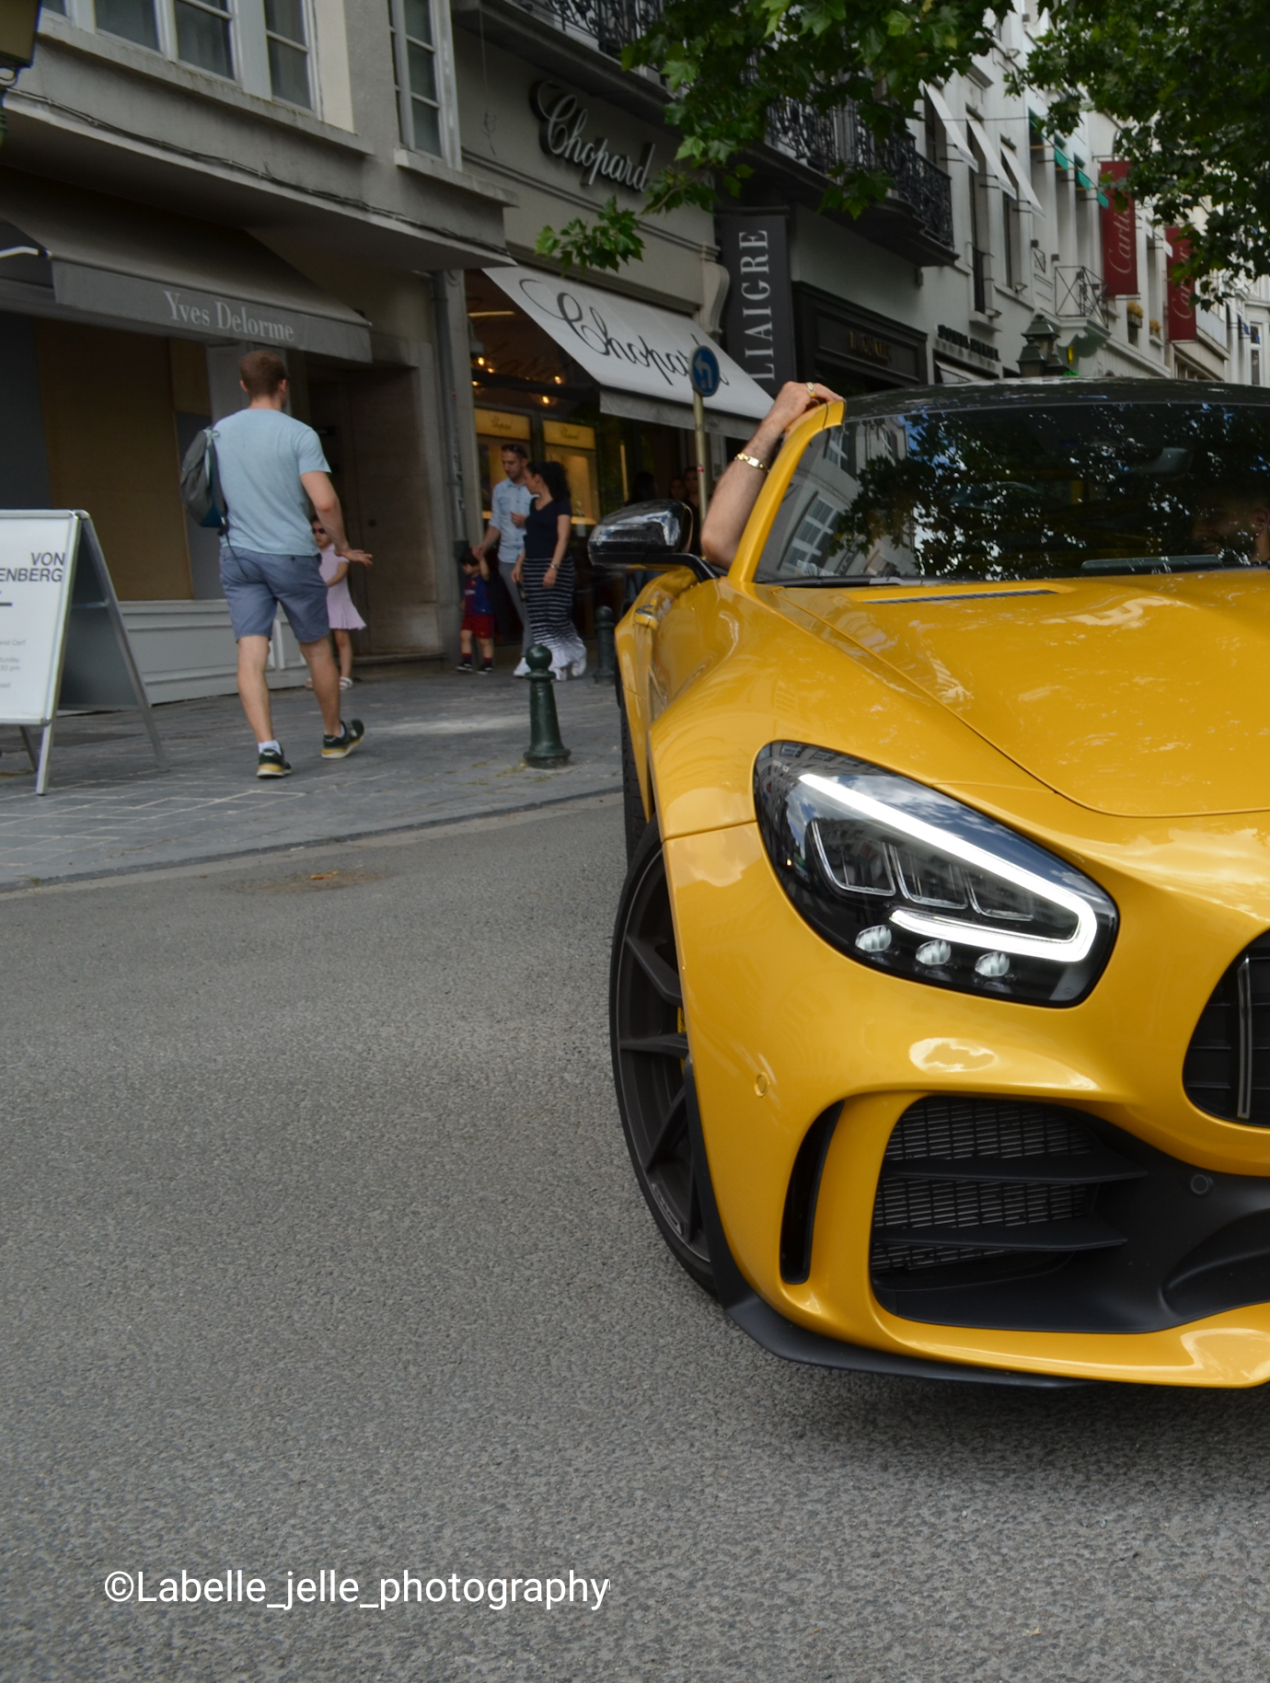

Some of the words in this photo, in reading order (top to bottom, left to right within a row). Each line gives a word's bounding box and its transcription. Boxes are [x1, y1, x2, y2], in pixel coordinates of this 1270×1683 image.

[534, 79, 657, 194] Chopard
[163, 290, 211, 327] Yves
[214, 301, 296, 342] Delorme
[518, 278, 730, 387] Chopa
[738, 229, 776, 381] LIAIGRE
[31, 551, 66, 567] VON
